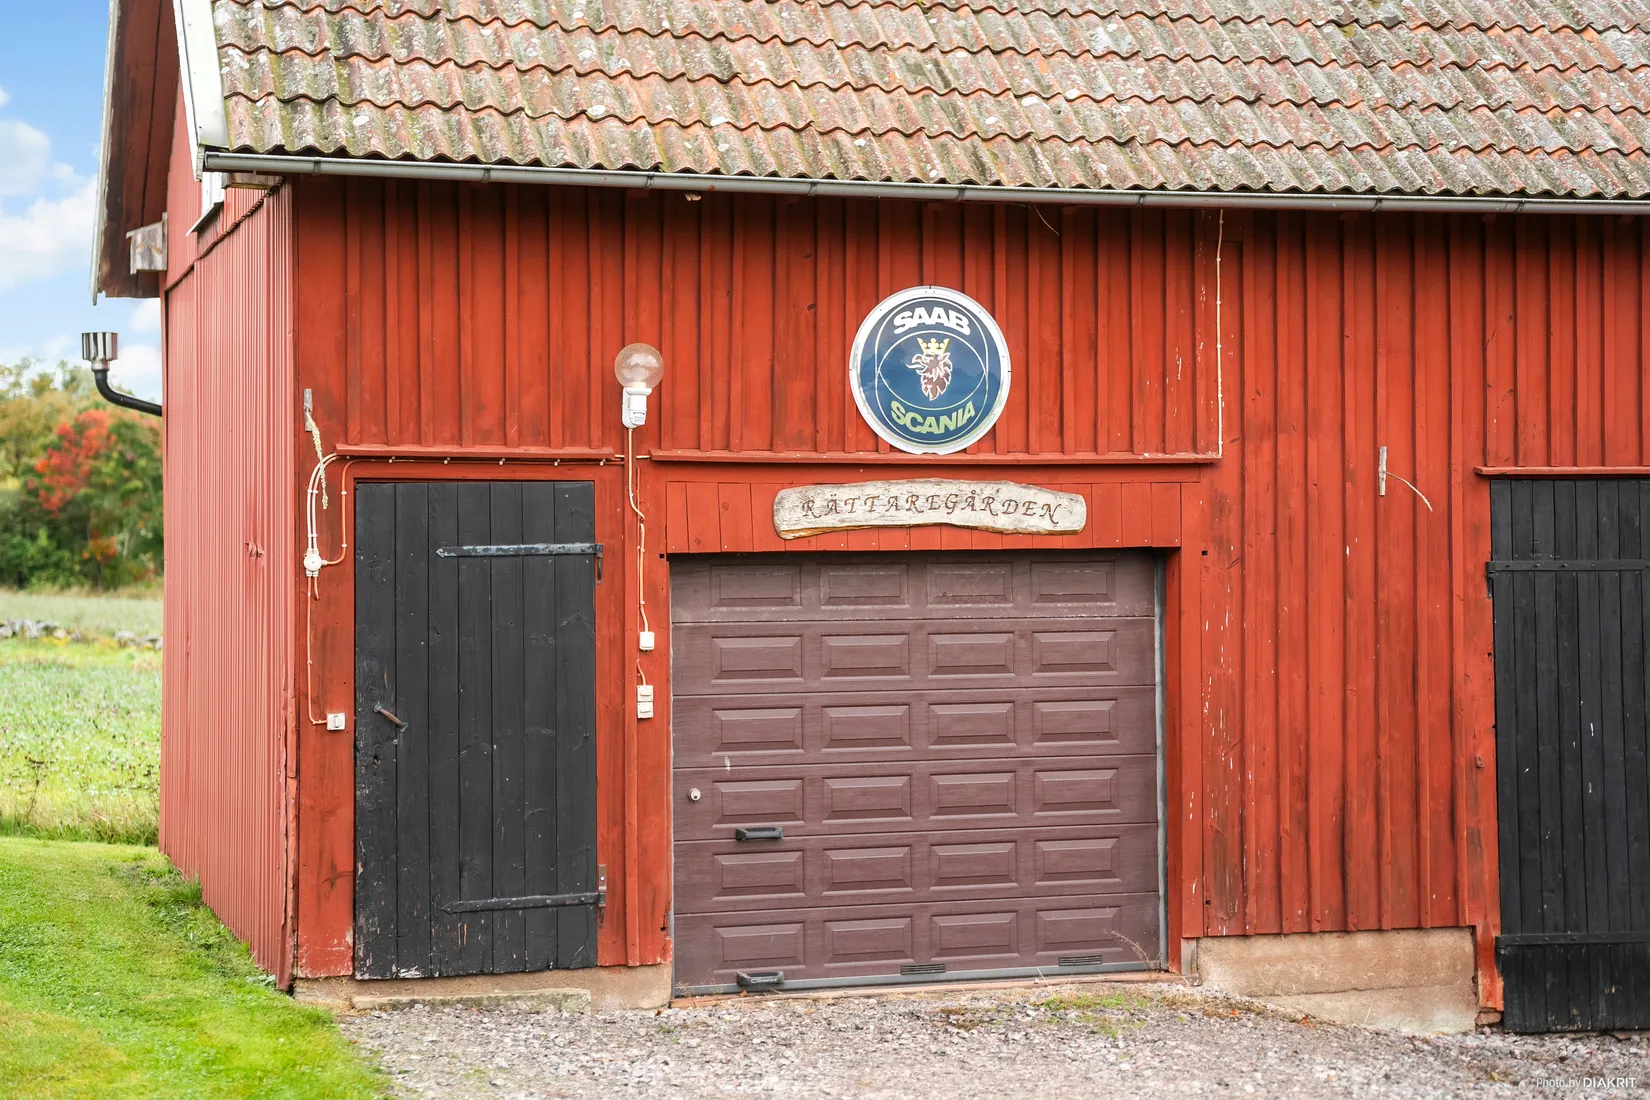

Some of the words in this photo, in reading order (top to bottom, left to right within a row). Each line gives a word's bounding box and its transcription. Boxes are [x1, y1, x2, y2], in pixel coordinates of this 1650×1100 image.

[893, 306, 971, 336] SAAB
[890, 400, 976, 435] SCANIA
[801, 489, 1062, 525] RÄTTAREGÅRDEN
